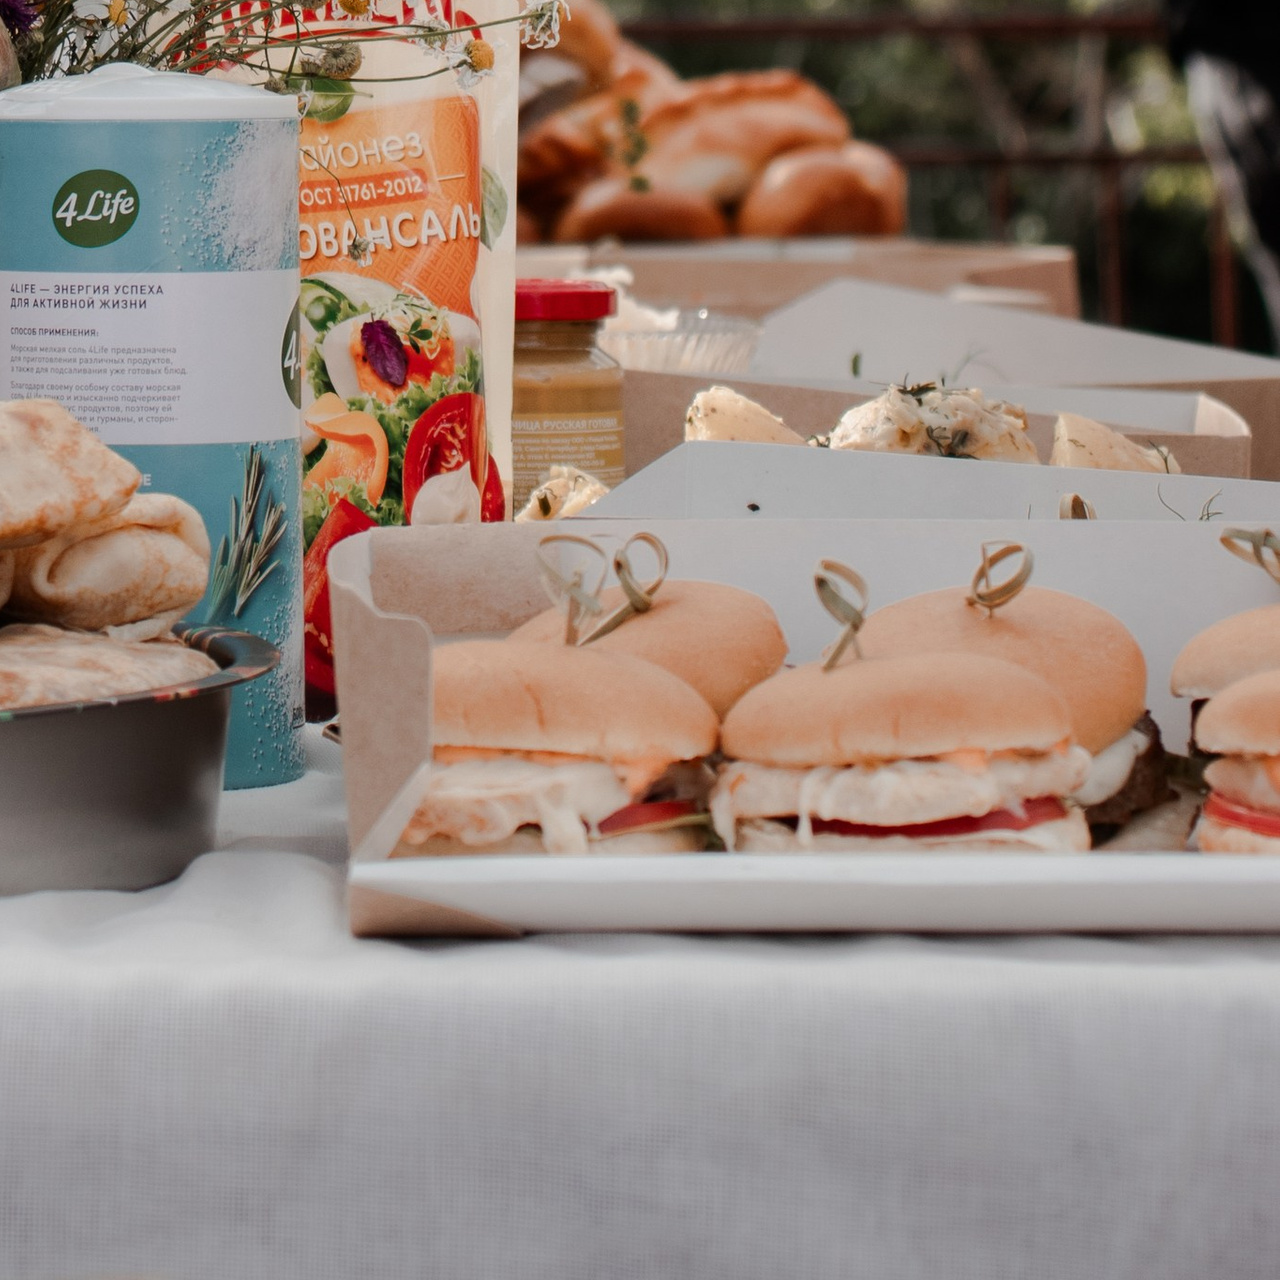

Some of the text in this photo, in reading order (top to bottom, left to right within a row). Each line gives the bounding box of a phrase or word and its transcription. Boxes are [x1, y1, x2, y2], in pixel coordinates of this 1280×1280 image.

[300, 132, 425, 172] айонез
[300, 175, 425, 208] ОСТ 31761-2012
[55, 189, 136, 228] 4Life
[300, 202, 482, 262] ОВАНСАЛЬ
[10, 283, 37, 294] 4LIFE
[53, 284, 111, 295] ЭНЕРГИЯ
[114, 284, 165, 296] УСПЕХА
[10, 296, 148, 310] ДЛЯ АКТИВНОЙ ЖИЗНИ
[10, 327, 100, 338] СПОСОБ ПРИМЕНЕНИЯ:
[67, 346, 87, 354] соль
[109, 368, 126, 377] уже
[127, 368, 162, 376] готовых
[74, 382, 110, 394] особому
[110, 384, 144, 394] составу
[73, 394, 120, 403] изысканно
[124, 405, 160, 415] поэтому
